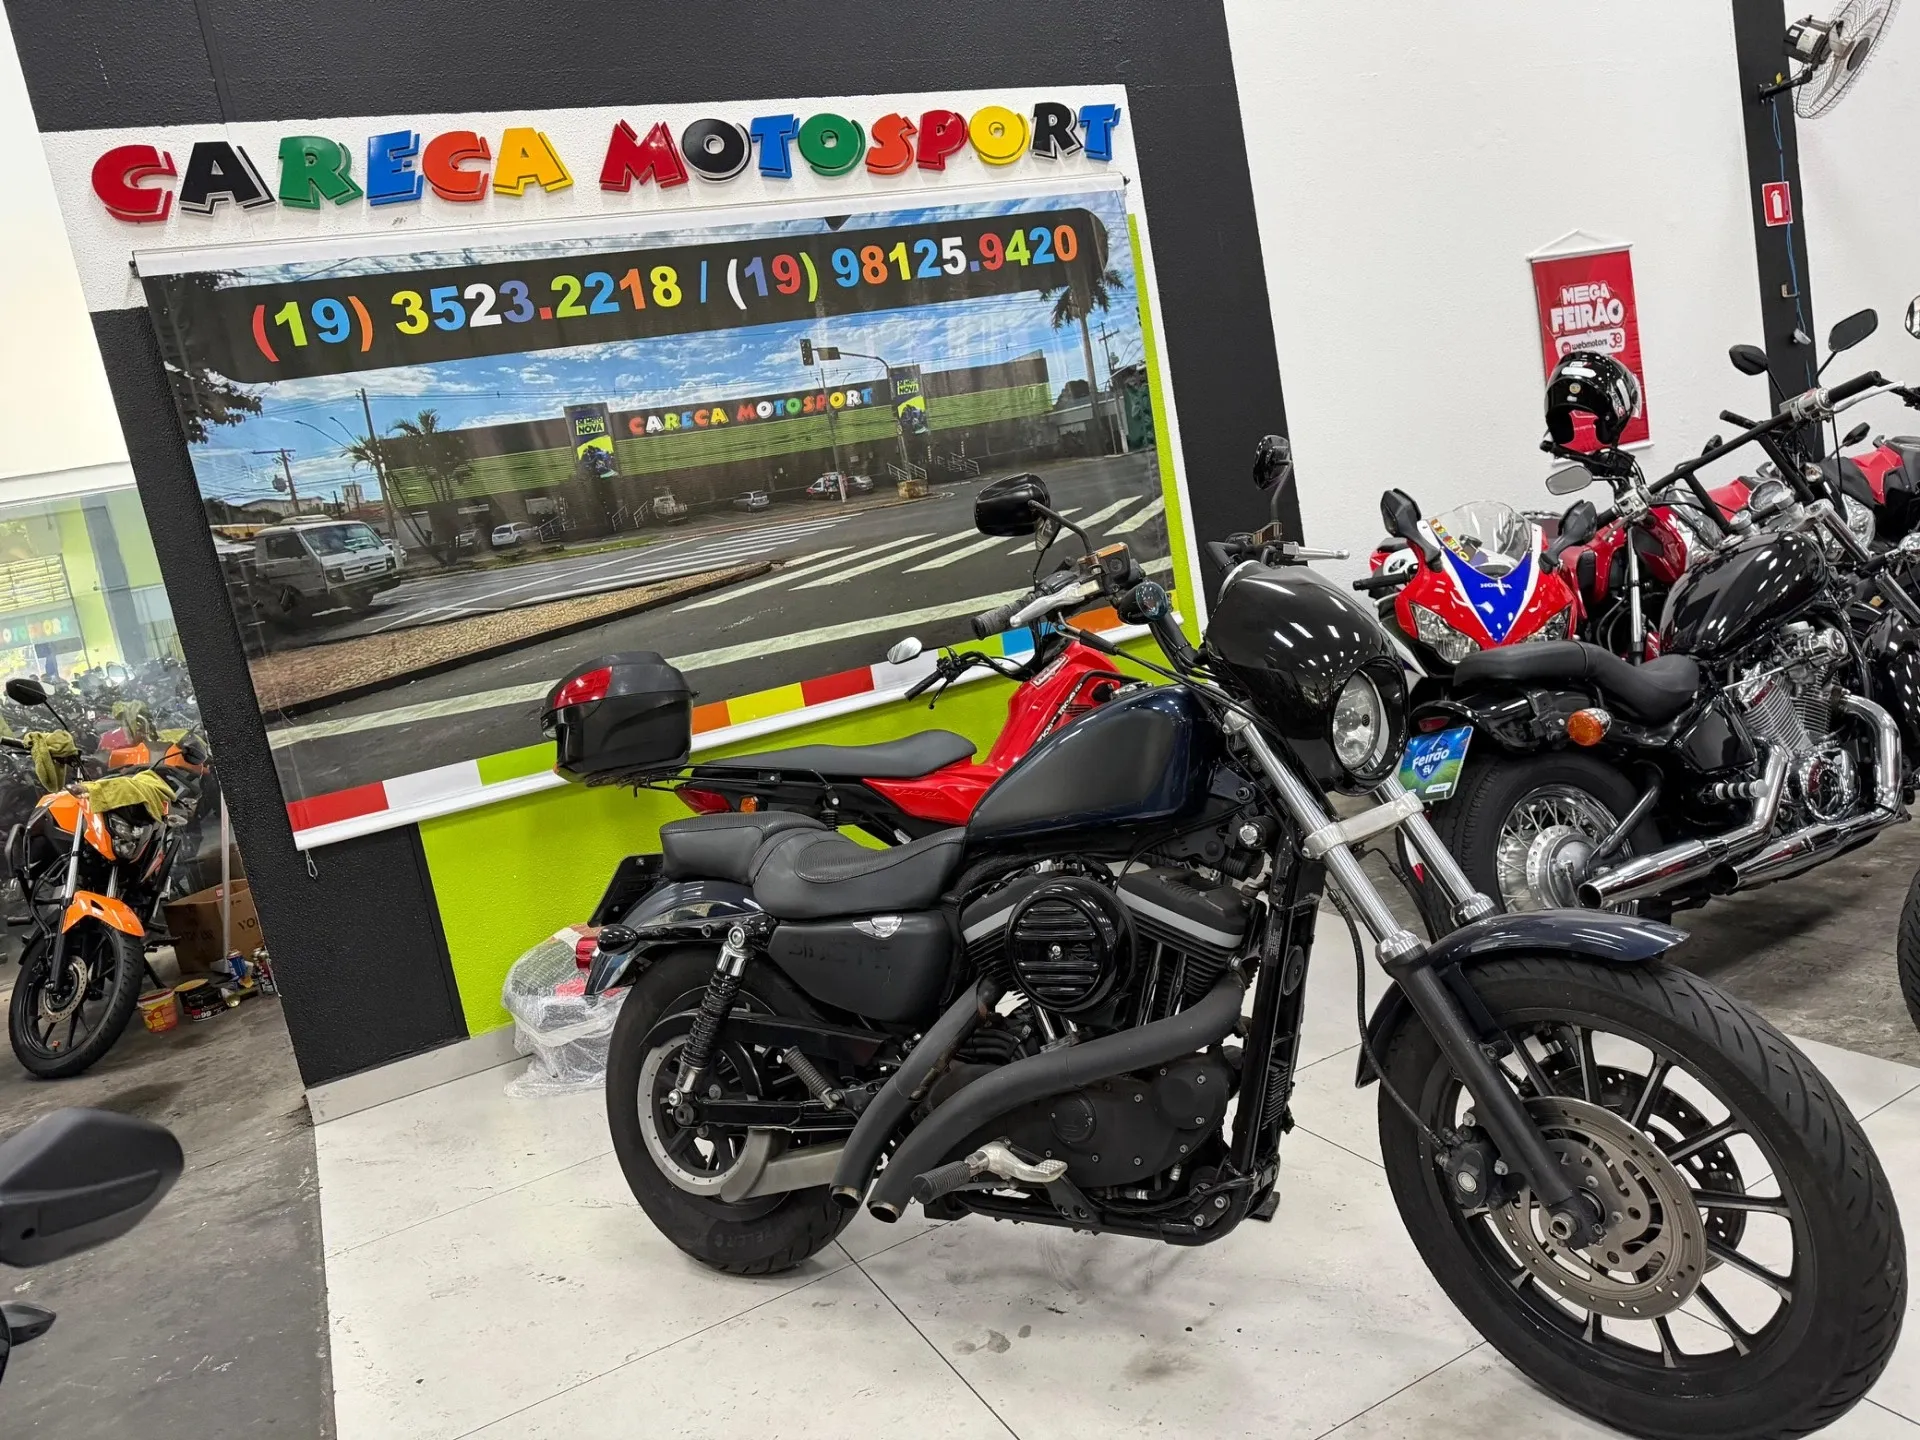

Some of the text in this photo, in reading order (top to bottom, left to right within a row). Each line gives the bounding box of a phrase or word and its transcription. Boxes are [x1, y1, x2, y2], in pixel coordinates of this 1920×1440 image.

[91, 101, 1120, 223] CARECA MOTOSPORT
[251, 294, 374, 362] (19)
[391, 264, 682, 335] 3523.2218
[727, 251, 819, 311] (19)
[832, 225, 1078, 288] 98125.9420
[1561, 283, 1611, 305] MEGA
[1550, 298, 1624, 333] FEIRÃO
[578, 423, 603, 434] NOVA
[628, 387, 873, 436] CARECA MOTOSPORT
[1411, 747, 1450, 770] Feirão
